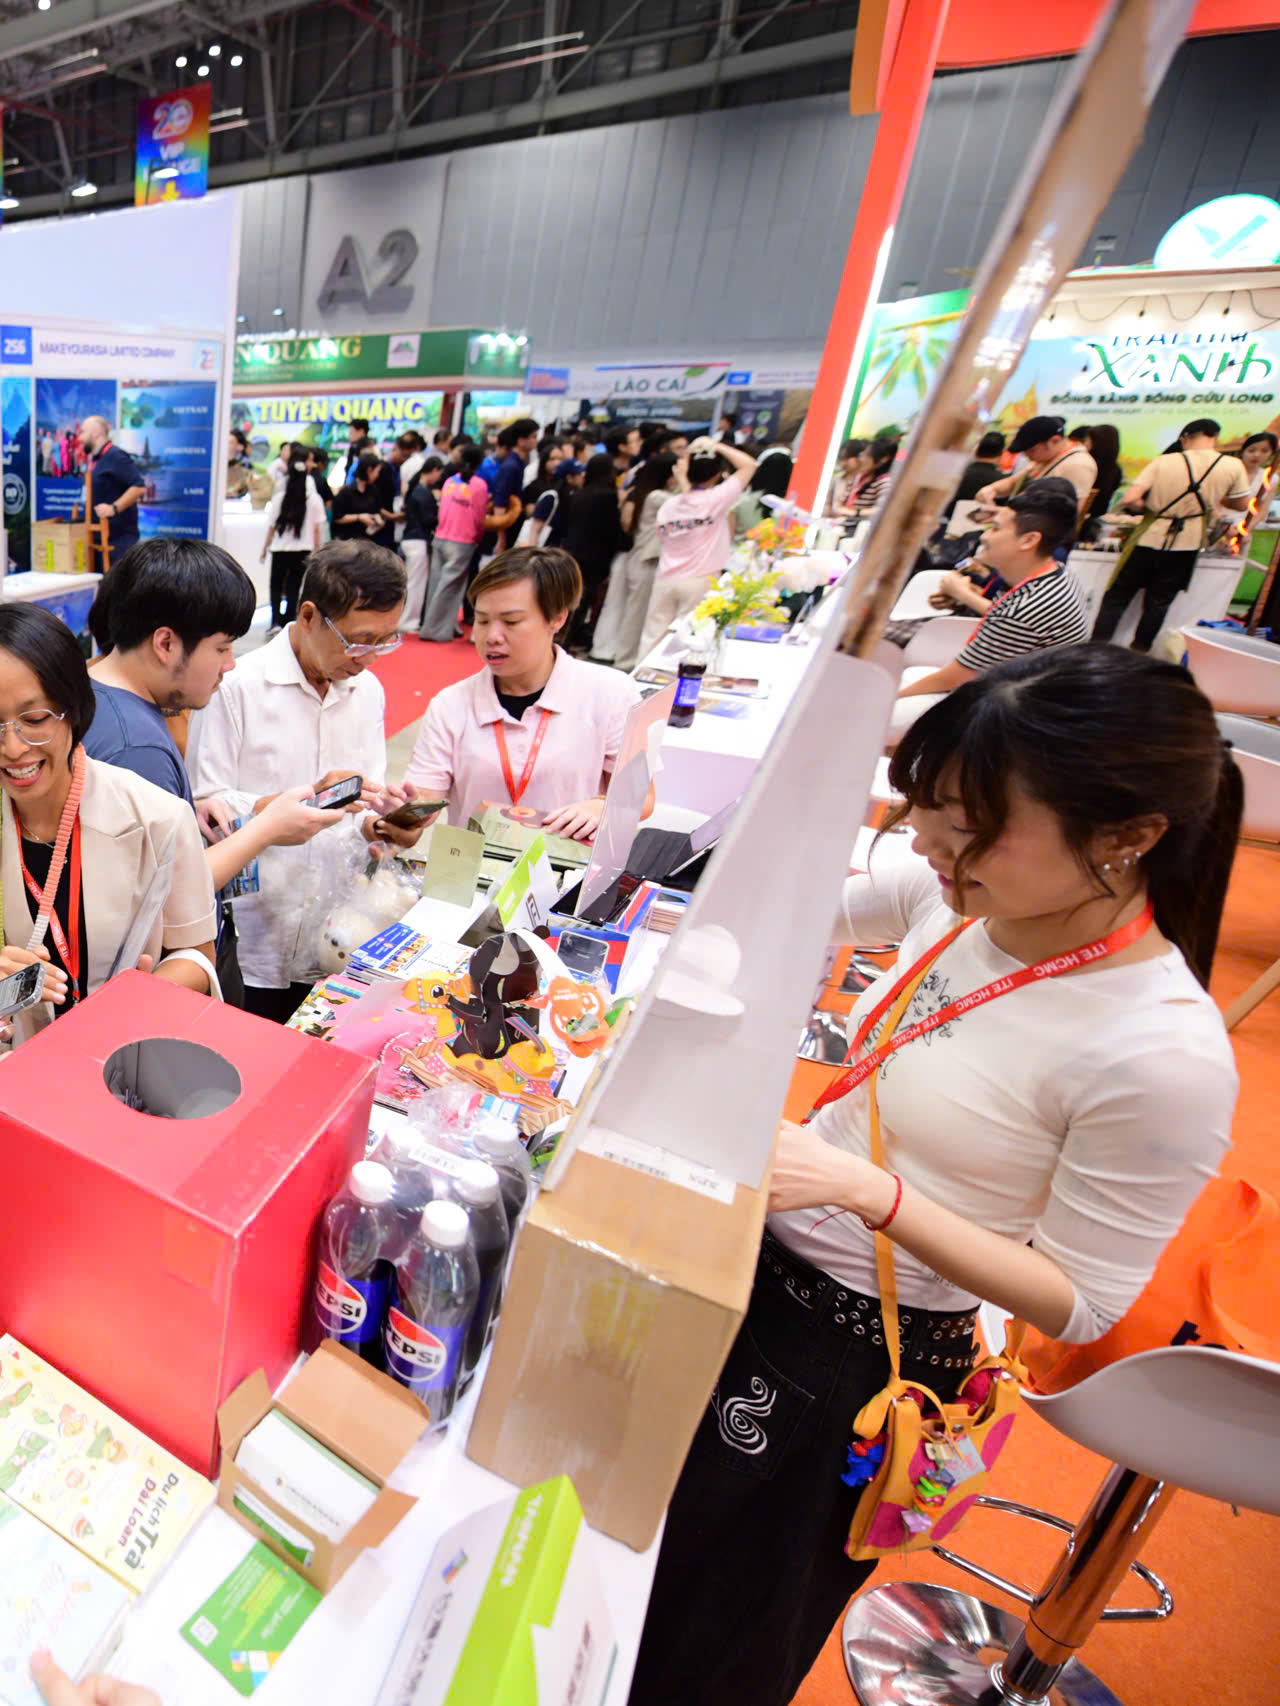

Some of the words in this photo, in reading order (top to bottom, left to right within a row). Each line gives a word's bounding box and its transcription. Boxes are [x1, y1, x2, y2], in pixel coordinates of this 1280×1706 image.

[160, 141, 185, 161] VIP
[319, 227, 420, 312] A2
[263, 336, 363, 364] QUANG
[1086, 343, 1273, 388] XANH
[614, 374, 651, 392] LÀO
[171, 405, 208, 415] VIETNAM
[258, 391, 328, 423] TUYÊN
[332, 397, 424, 424] QUANG
[1228, 393, 1274, 404] LONG
[1079, 943, 1109, 963] ITE
[1033, 954, 1080, 978] HCMC
[991, 977, 1014, 995] ITE
[956, 987, 992, 1012] HCMC
[922, 1014, 940, 1031] ITE
[891, 1024, 922, 1049] HCMC
[867, 1052, 881, 1069] ITE
[846, 1063, 869, 1087] HCMC
[318, 1286, 362, 1319] EPSI
[162, 1472, 180, 1496] Du
[148, 1495, 169, 1527] lịch
[118, 1507, 145, 1548] Loan
[123, 1523, 160, 1571] Trà
